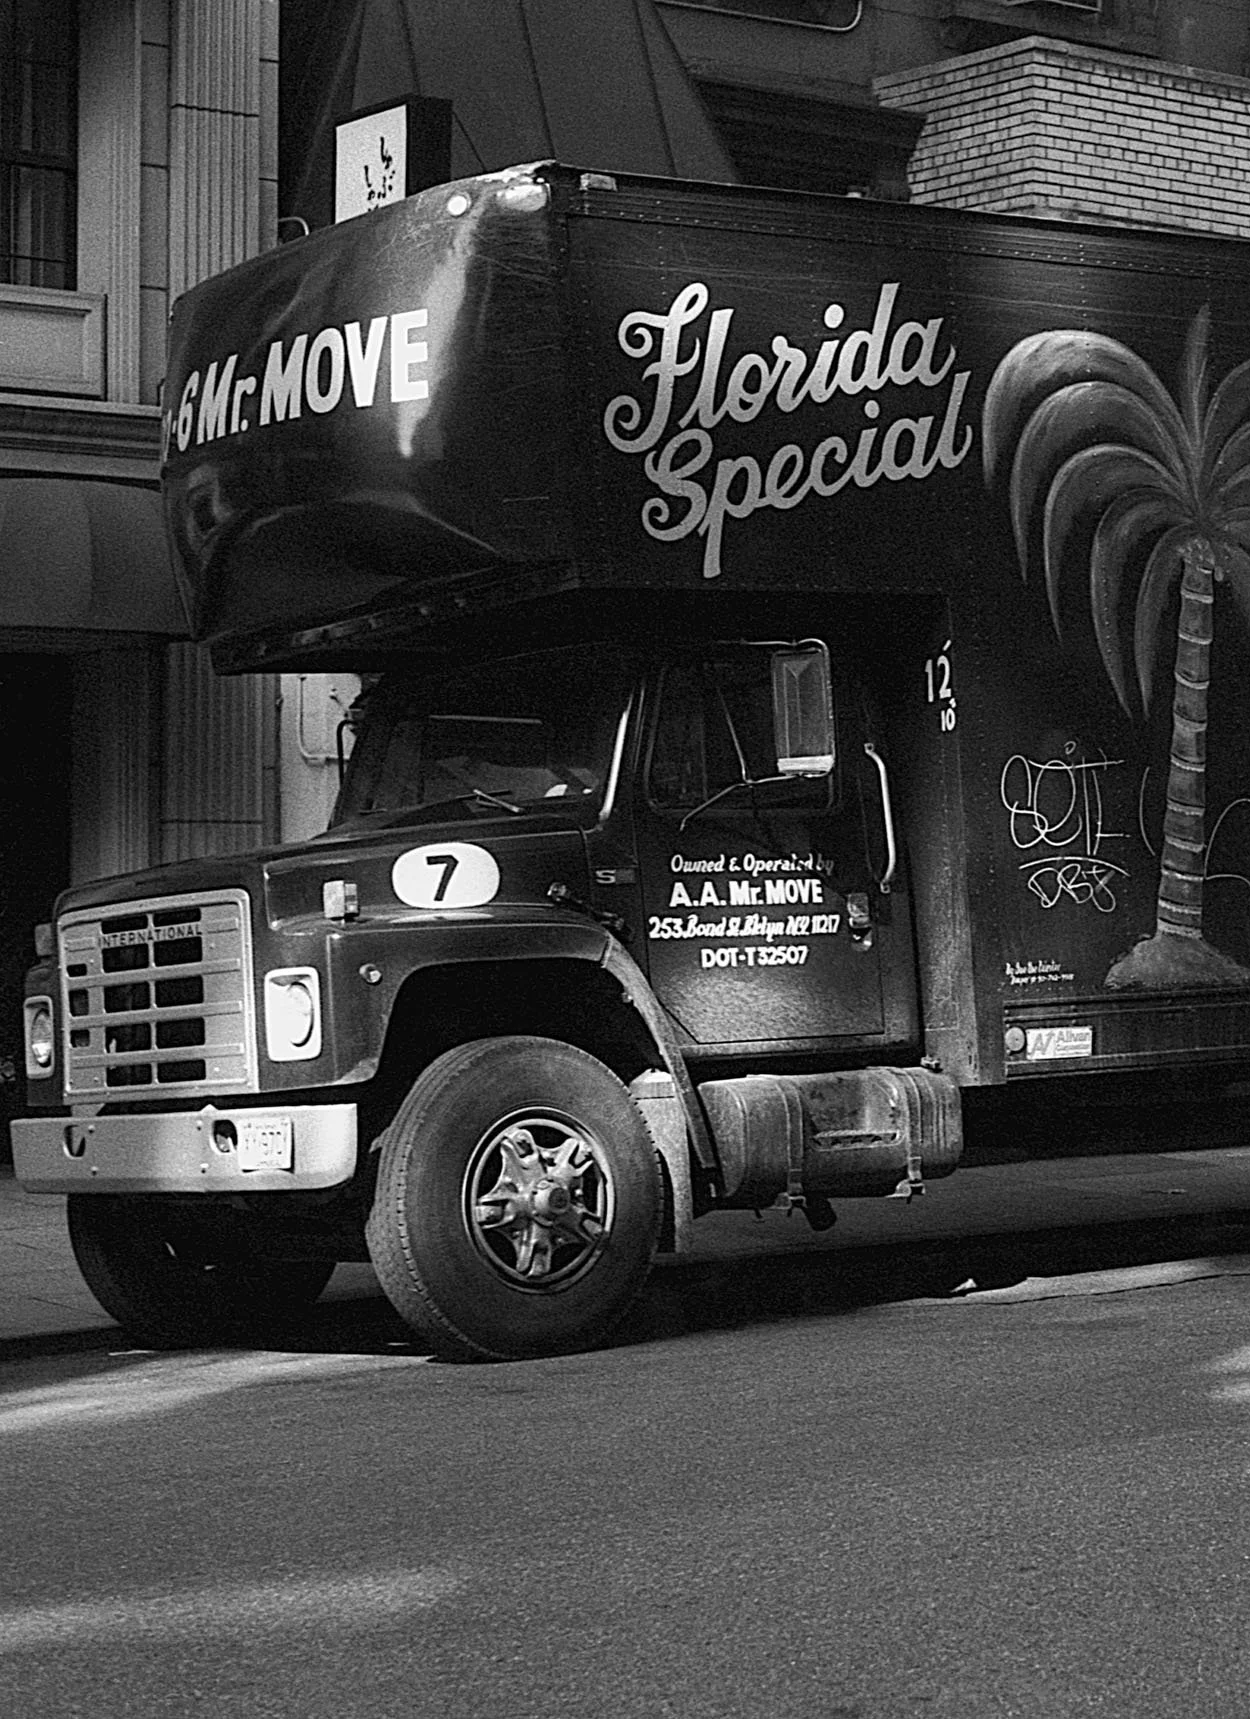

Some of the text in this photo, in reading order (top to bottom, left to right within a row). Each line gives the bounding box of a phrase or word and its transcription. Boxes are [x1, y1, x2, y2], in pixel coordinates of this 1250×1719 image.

[196, 353, 257, 446] Mr.
[258, 308, 430, 427] MOVE
[604, 282, 957, 453] Florida
[641, 370, 974, 578] Special
[425, 854, 460, 902] 7
[670, 852, 835, 878] Owned & Operated by
[668, 878, 824, 908] A.A. Mr. MOVE
[810, 914, 841, 935] 11217
